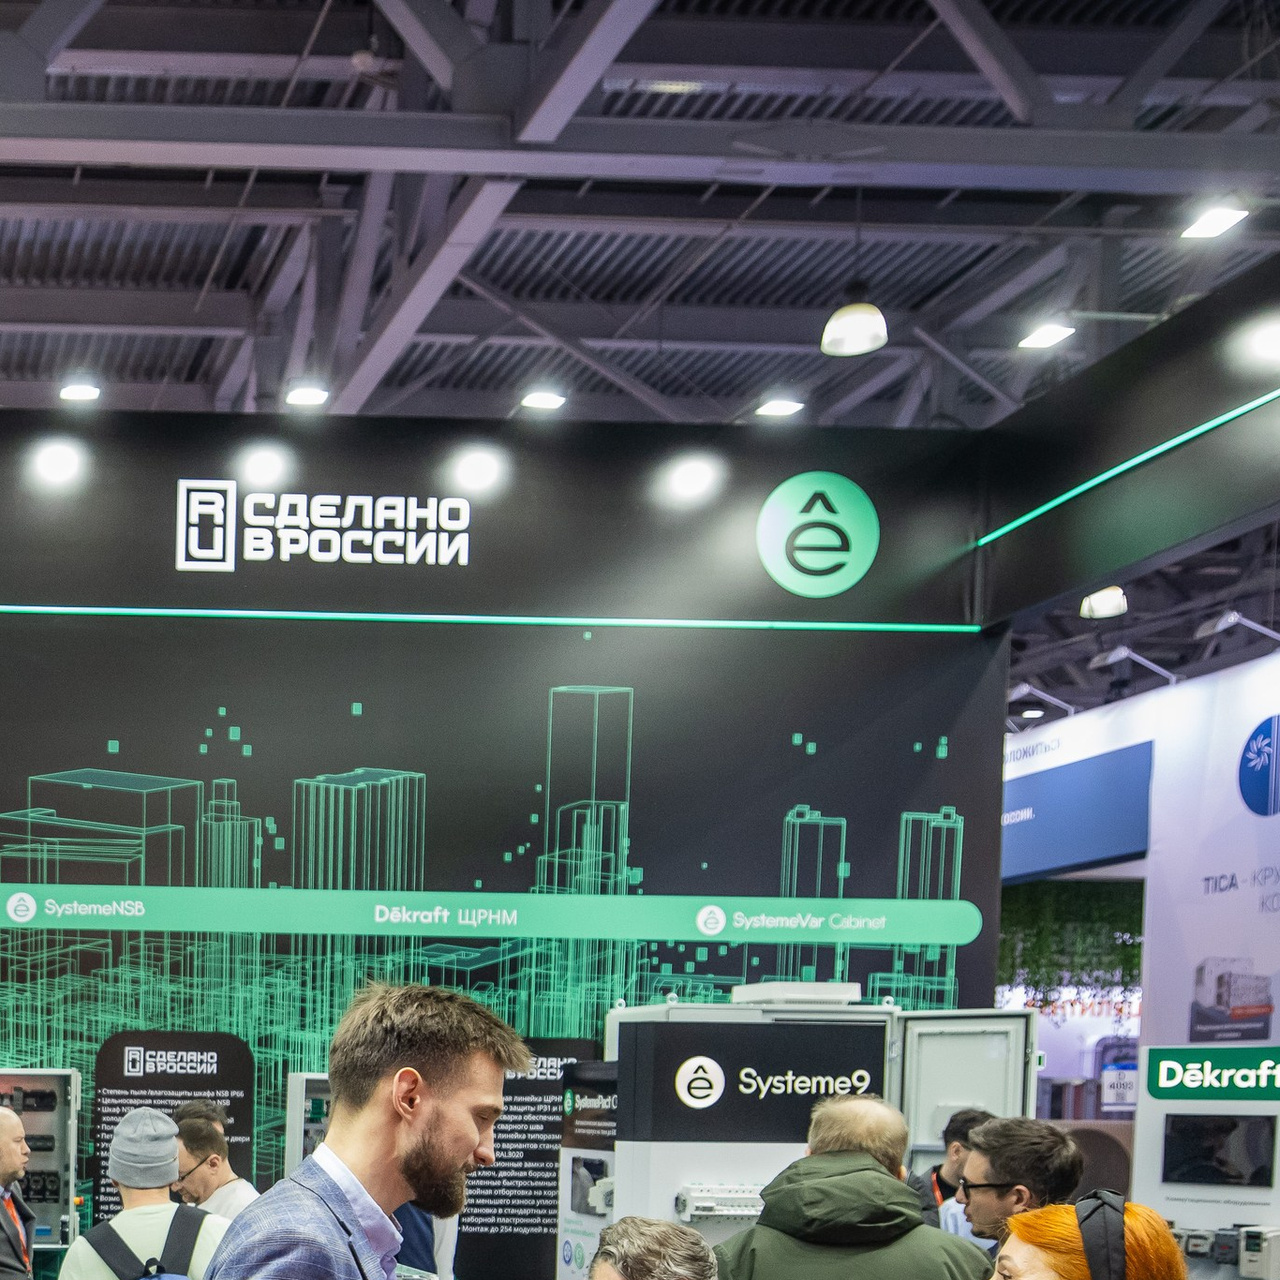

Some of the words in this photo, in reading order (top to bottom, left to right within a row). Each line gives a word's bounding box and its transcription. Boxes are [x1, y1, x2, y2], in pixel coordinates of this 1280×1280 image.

[243, 493, 470, 531] СДЕЛАНО
[1203, 872, 1239, 895] TICA
[45, 898, 145, 920] SystemeNSB
[458, 907, 518, 927] ЩРНМ
[732, 910, 824, 932] SystemeVar
[829, 912, 886, 930] Cabinet
[145, 1050, 218, 1062] СДЕЛАНО
[739, 1067, 871, 1100] Systeme9
[102, 1088, 129, 1096] Степень
[194, 1090, 215, 1098] шкафа
[528, 1170, 557, 1178] бородка
[502, 1179, 557, 1187] быстросъемные
[494, 1188, 532, 1196] отбортовка
[504, 1208, 547, 1216] стандартных
